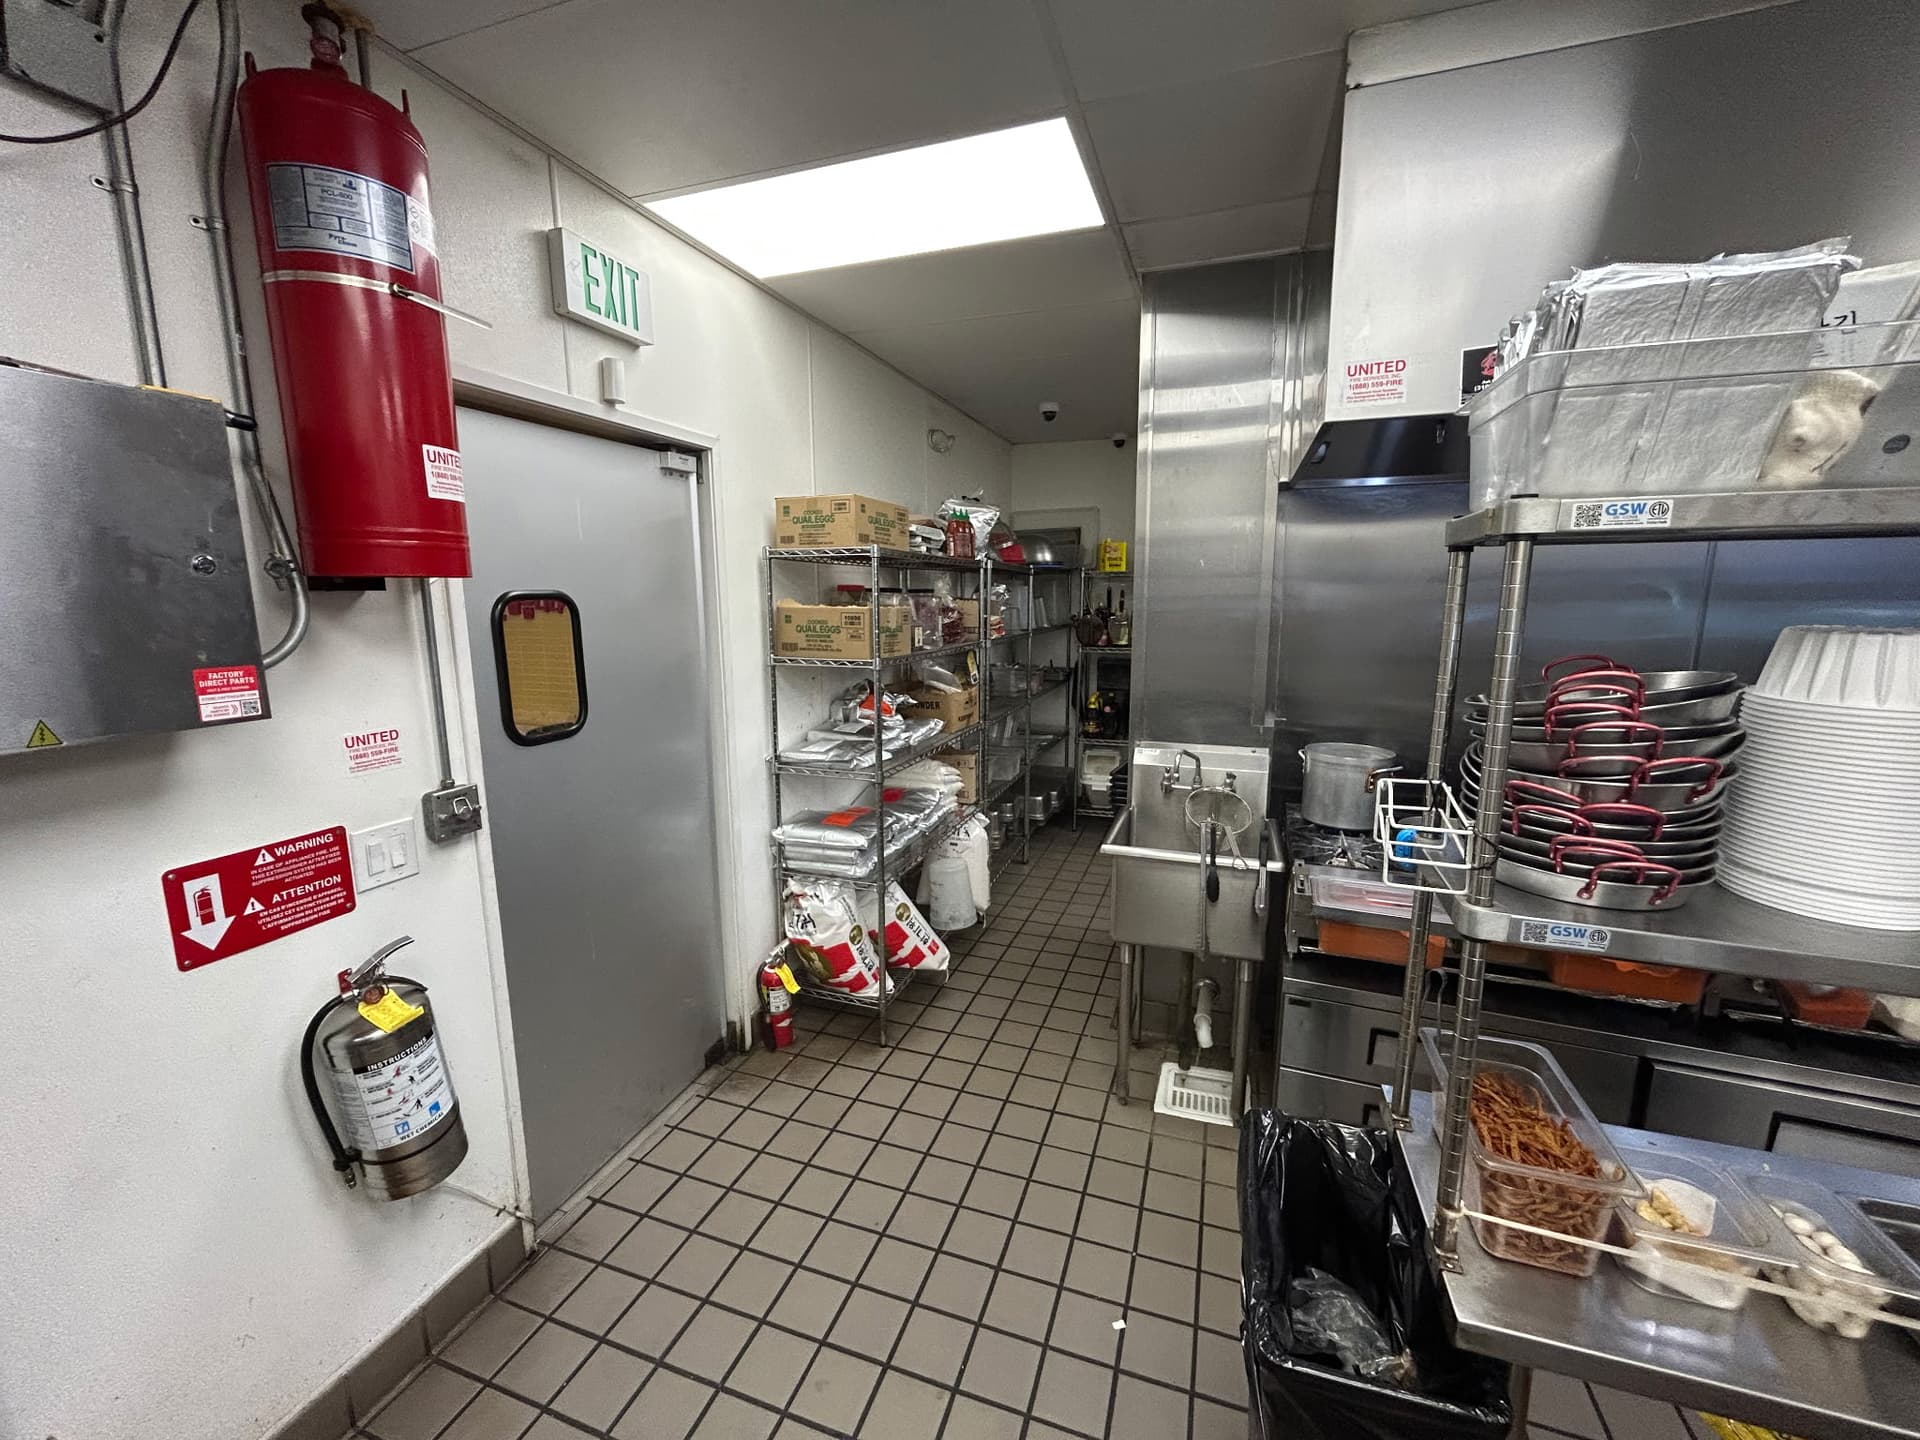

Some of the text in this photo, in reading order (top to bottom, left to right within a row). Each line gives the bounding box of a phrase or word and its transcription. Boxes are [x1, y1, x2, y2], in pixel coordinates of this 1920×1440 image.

[580, 242, 639, 332] EXIT
[1347, 360, 1407, 377] UNITED
[426, 449, 463, 470] UNITE
[1605, 502, 1647, 516] GSW
[792, 514, 835, 525] QUAIL EGGS
[796, 624, 842, 634] QUAIL EGGS
[199, 677, 255, 687] DIRECT PARTS
[208, 671, 244, 679] FACTORY
[344, 729, 399, 749] UNITED
[274, 833, 333, 857] WARNING
[271, 873, 341, 903] ATTENTION
[1550, 925, 1588, 939] GSW
[367, 1036, 427, 1071] INSTRUCTIONS
[415, 1111, 444, 1134] CHEMICAL
